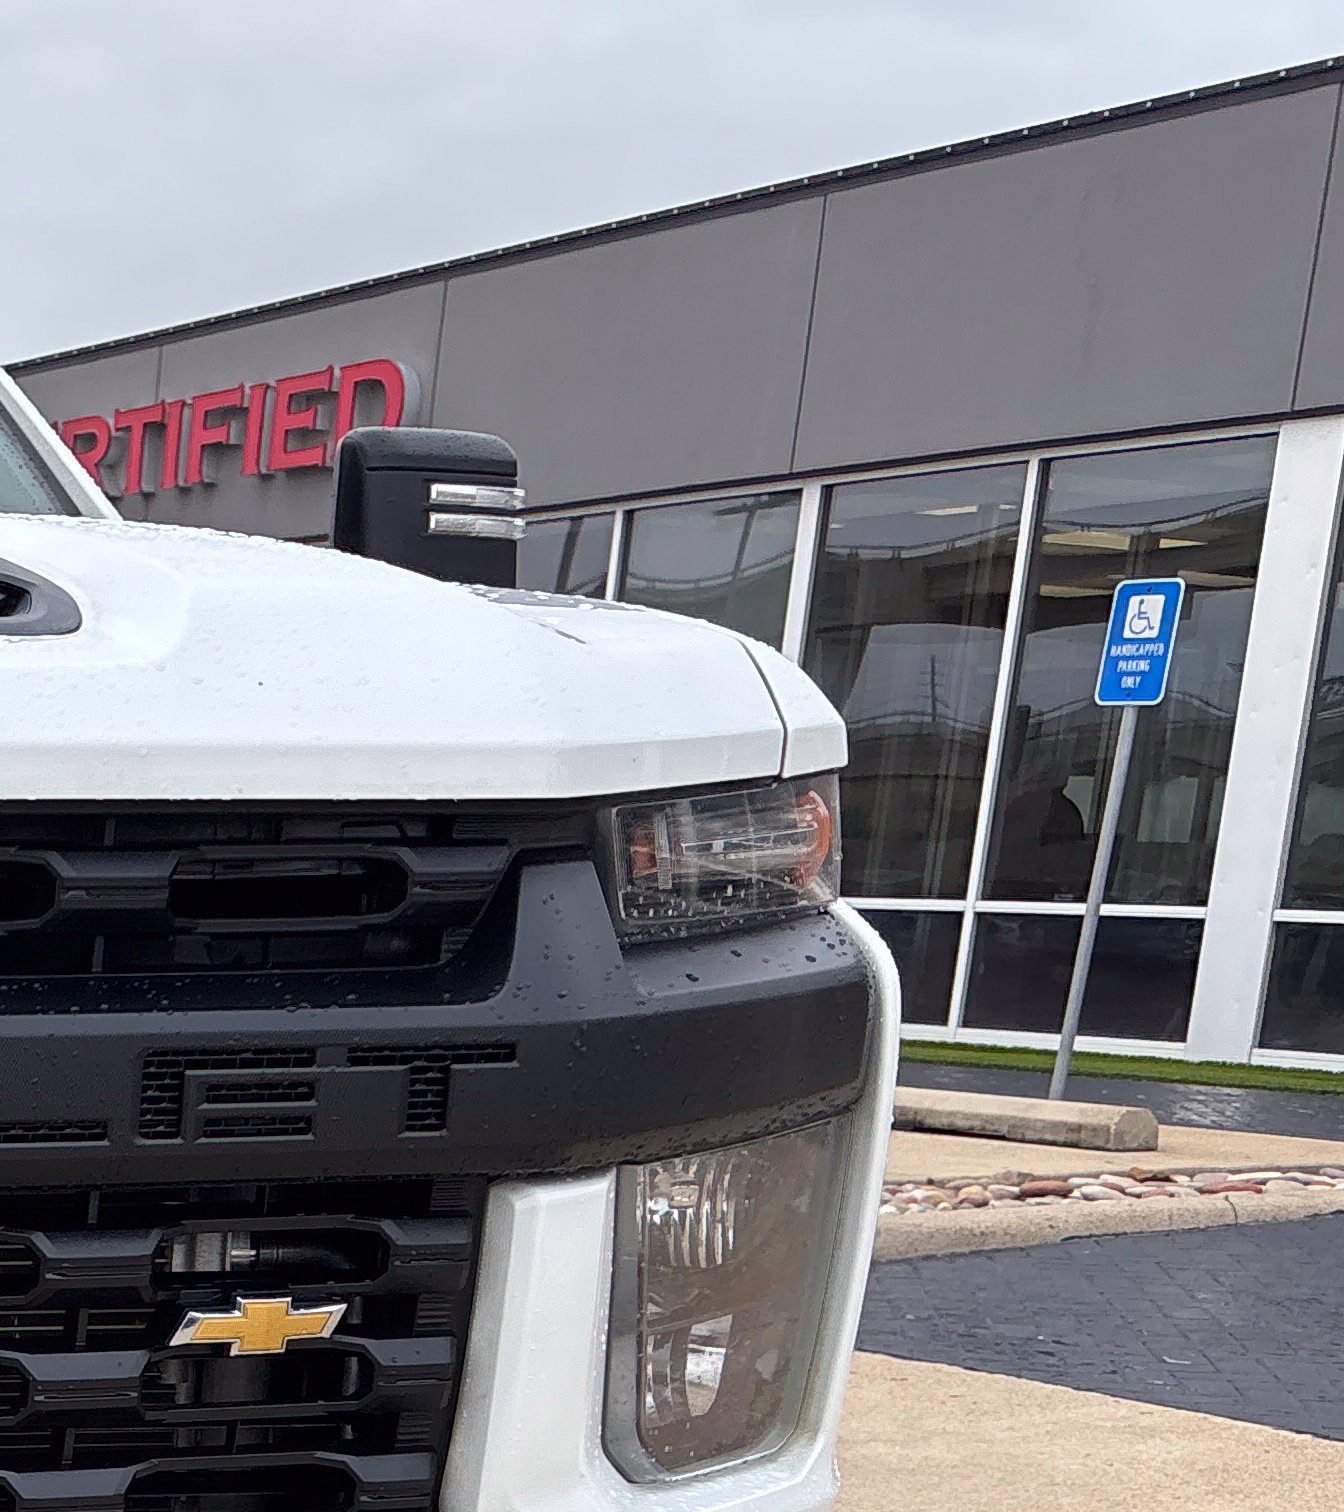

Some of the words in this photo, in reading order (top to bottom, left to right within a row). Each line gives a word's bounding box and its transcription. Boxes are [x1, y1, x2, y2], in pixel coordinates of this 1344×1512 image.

[50, 358, 405, 494] RTIFIED
[1110, 642, 1164, 656] HANDICAPPED
[1117, 659, 1150, 672] PARKING
[1121, 675, 1142, 689] ONLY
